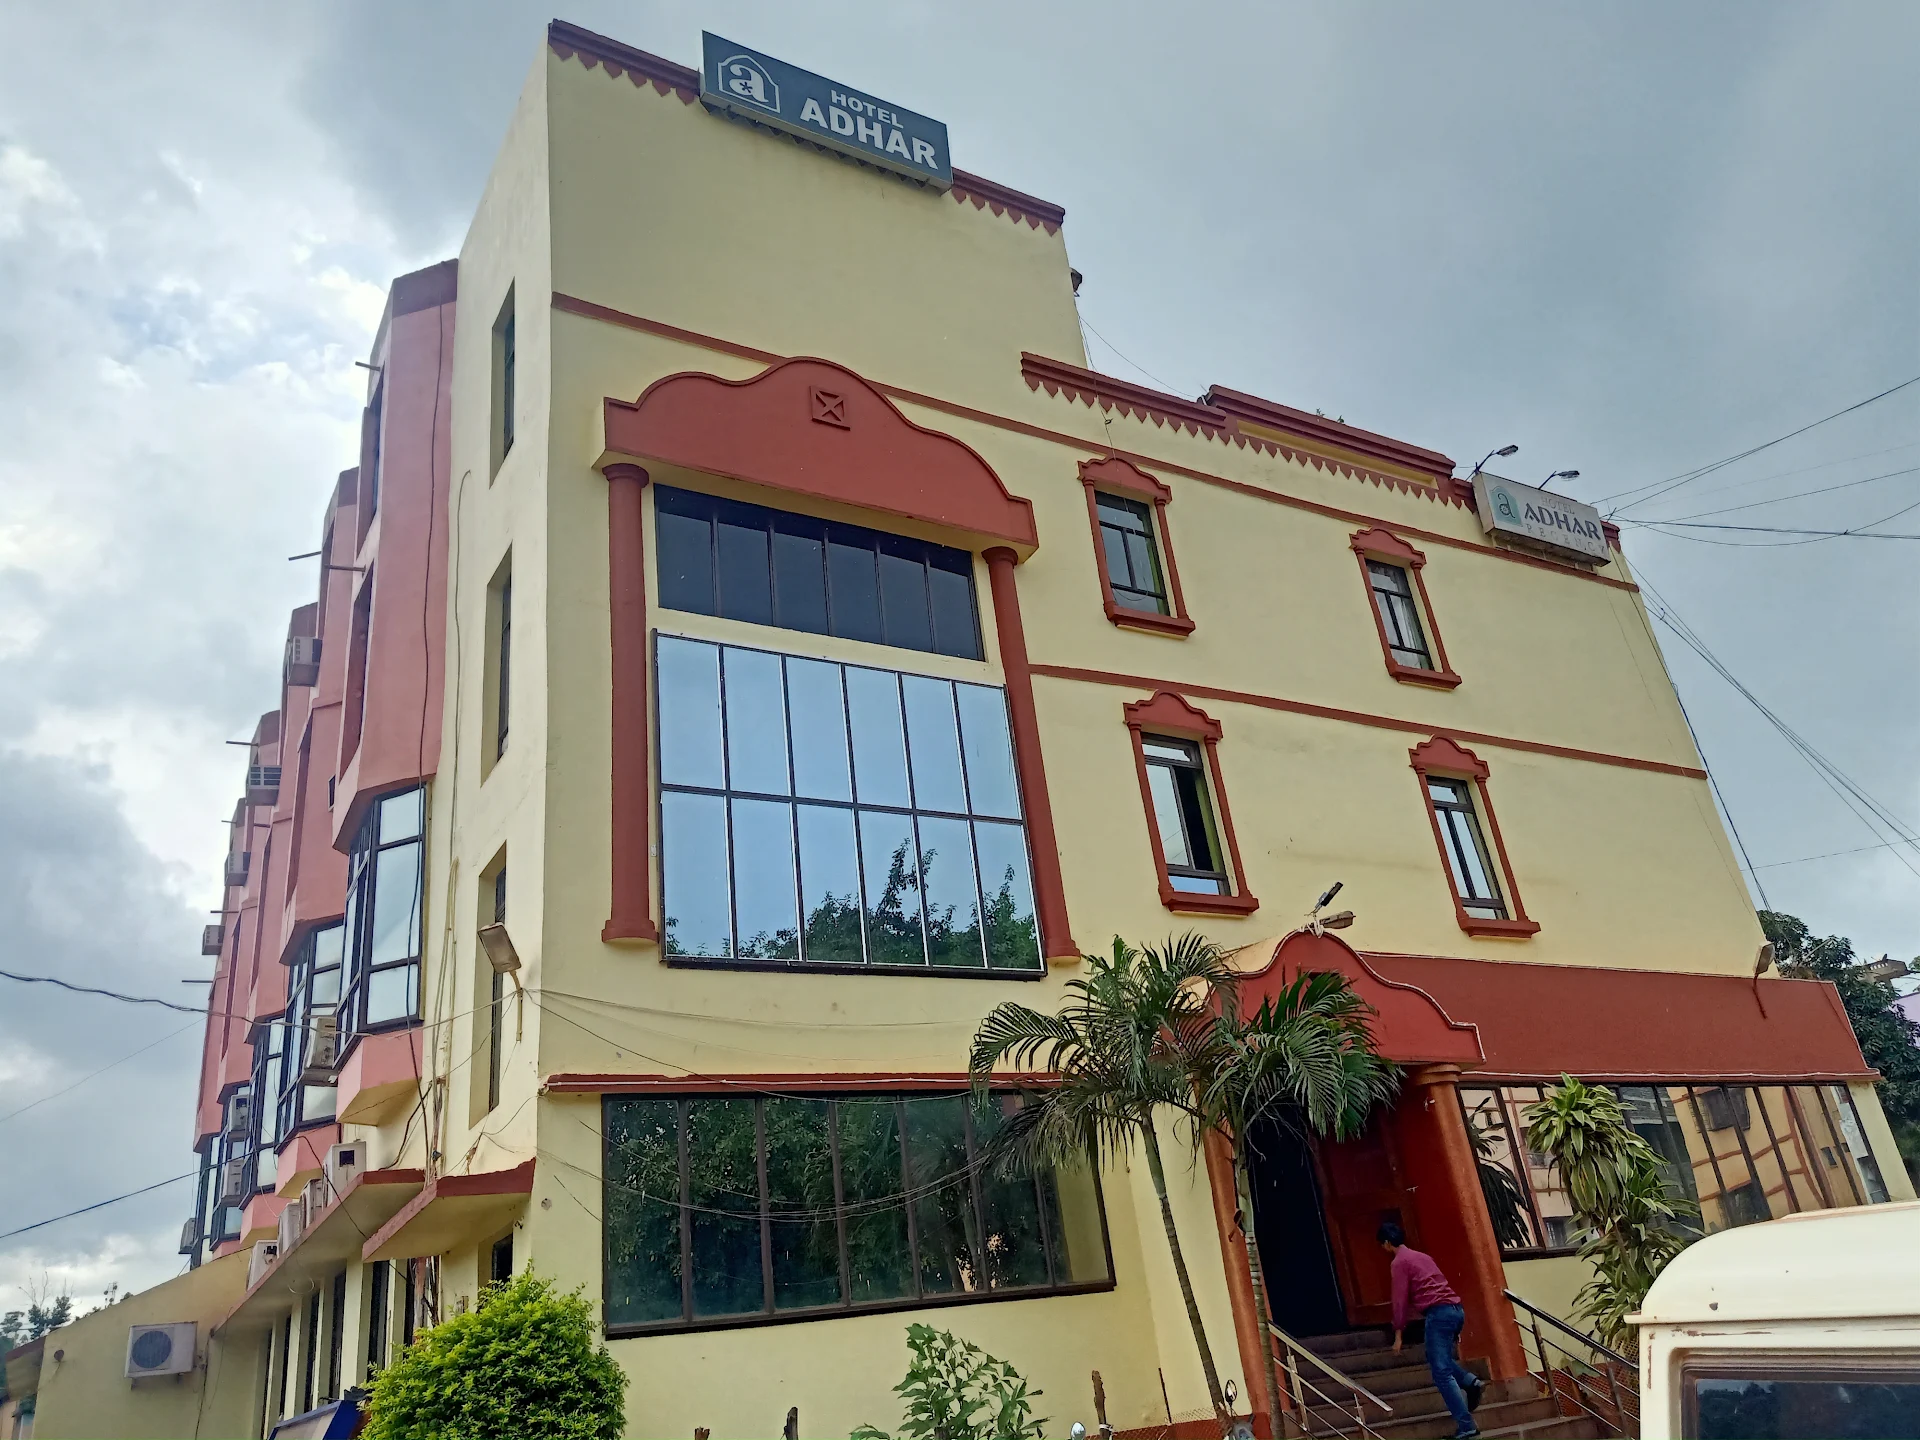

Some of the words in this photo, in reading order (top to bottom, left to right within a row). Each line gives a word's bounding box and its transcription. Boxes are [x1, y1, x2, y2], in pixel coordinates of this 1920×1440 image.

[830, 89, 904, 129] HOTEL
[799, 97, 939, 170] ADHAR
[1524, 502, 1602, 541] ADHAR
[1540, 496, 1576, 515] HOTEL
